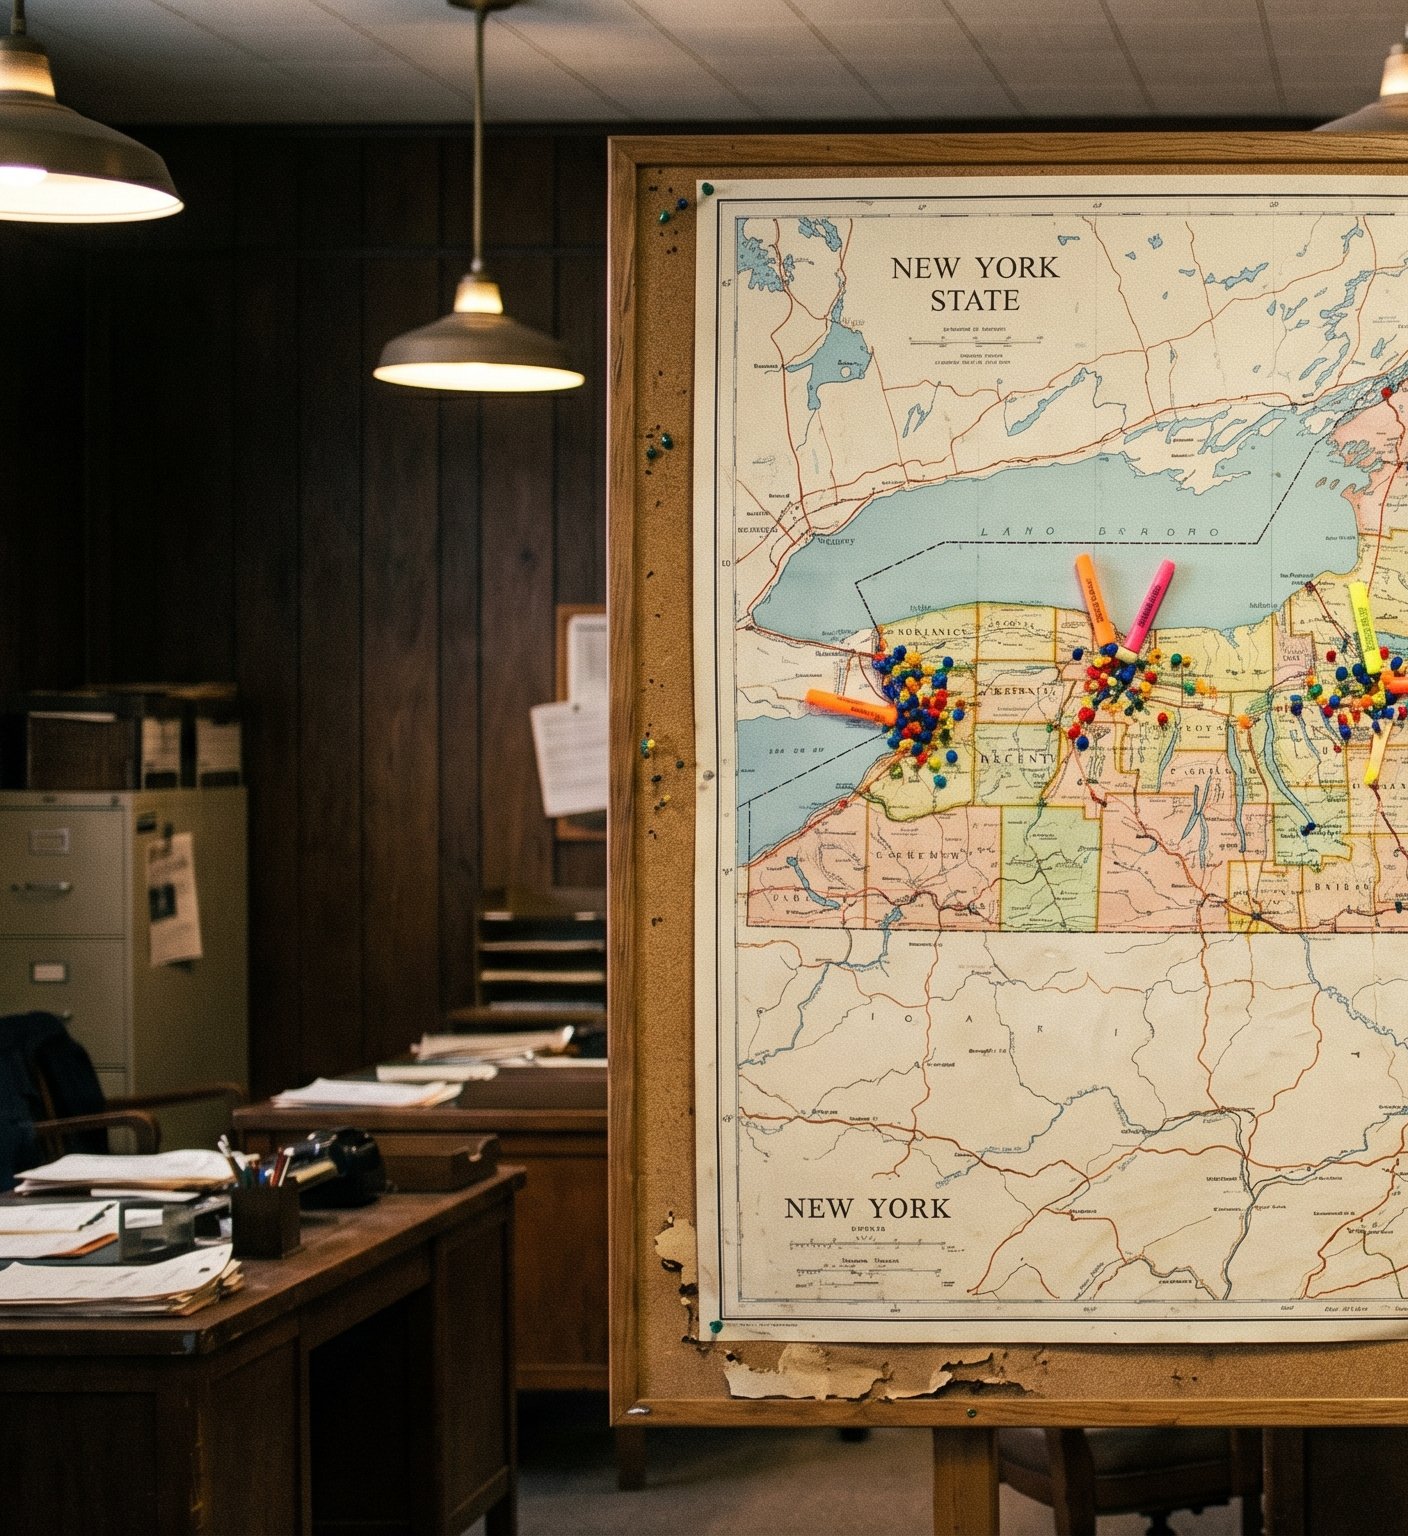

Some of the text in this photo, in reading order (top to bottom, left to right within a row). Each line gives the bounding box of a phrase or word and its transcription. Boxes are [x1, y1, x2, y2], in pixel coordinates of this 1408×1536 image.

[891, 256, 1061, 280] NEW YORK
[931, 289, 1021, 312] STATE
[784, 1197, 952, 1219] NEW YORK
